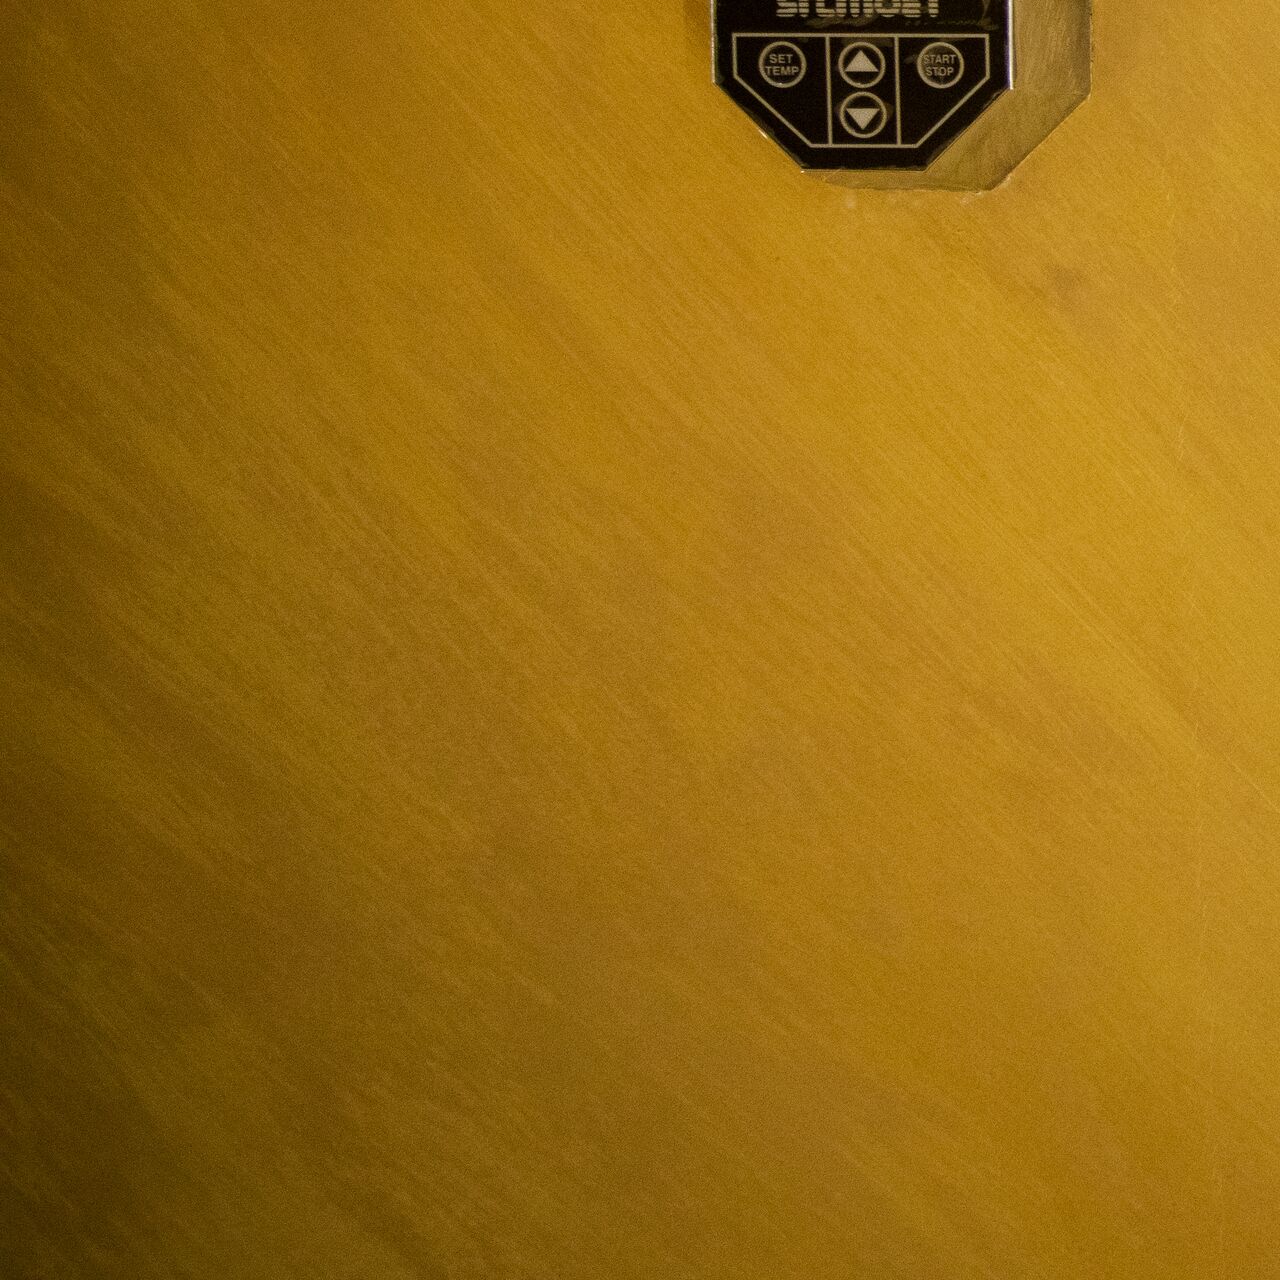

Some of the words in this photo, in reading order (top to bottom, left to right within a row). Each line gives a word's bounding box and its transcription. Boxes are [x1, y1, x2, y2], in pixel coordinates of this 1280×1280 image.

[769, 53, 794, 64] SET
[923, 54, 957, 65] START
[765, 66, 800, 77] TEMP
[925, 66, 955, 77] STOP
